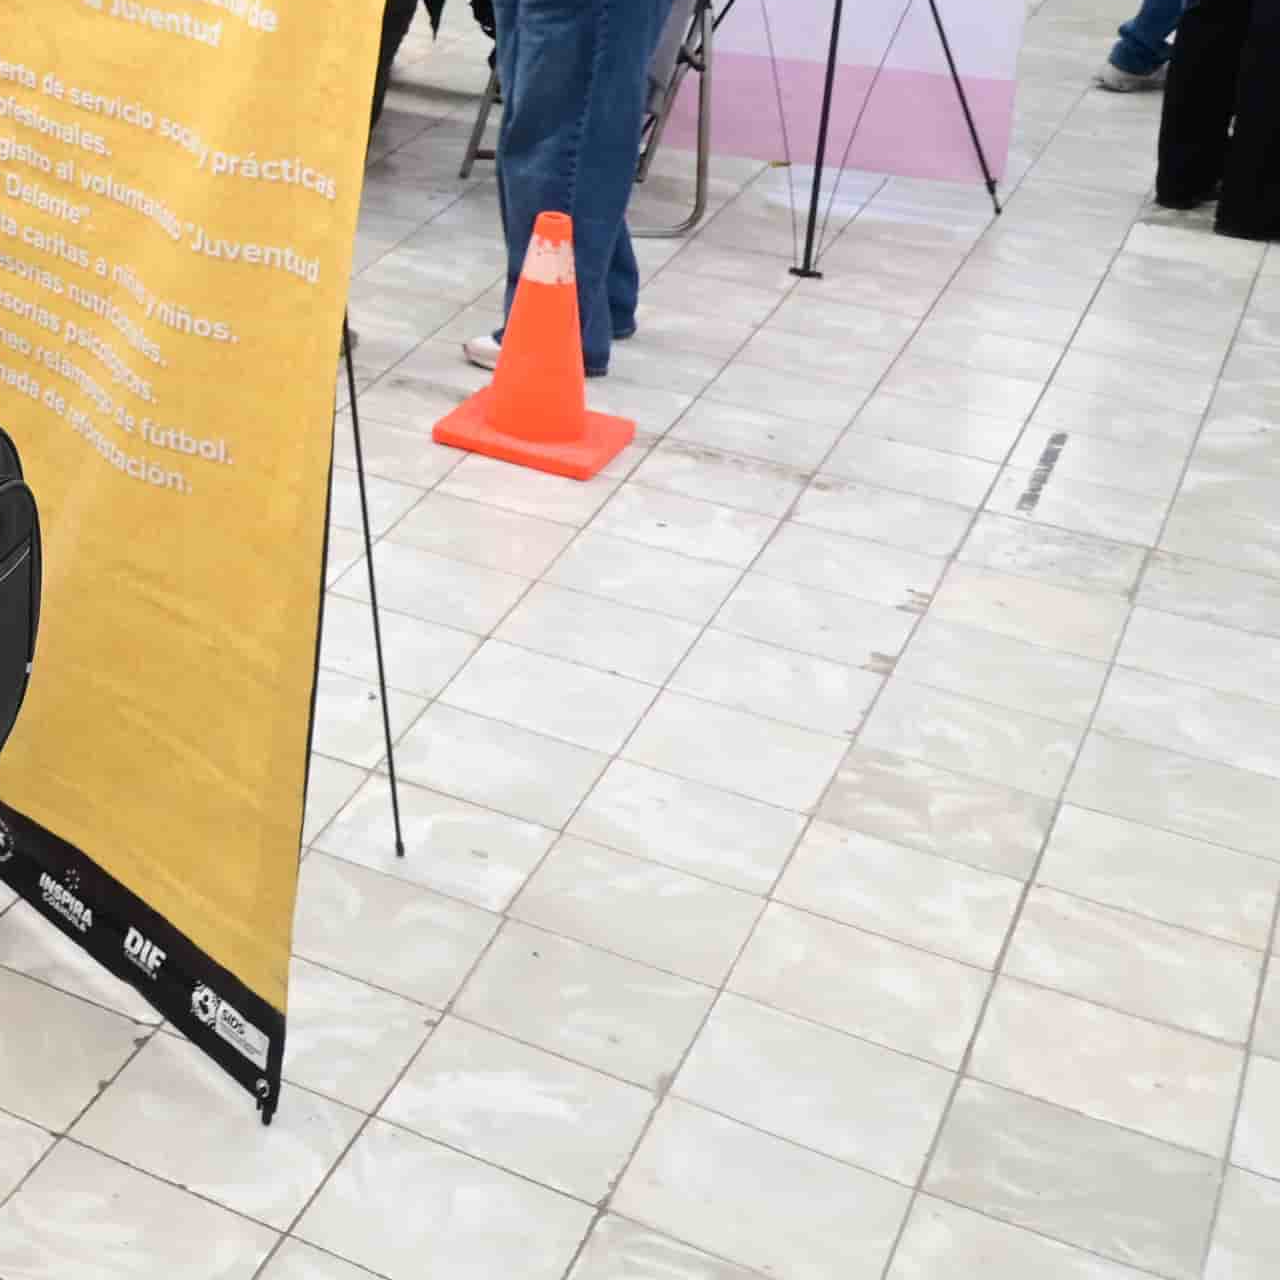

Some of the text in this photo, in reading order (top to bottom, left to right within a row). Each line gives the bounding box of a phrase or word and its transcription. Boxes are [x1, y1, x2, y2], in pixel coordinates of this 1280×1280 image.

[43, 73, 65, 101] de
[70, 86, 155, 129] servicio
[213, 151, 337, 201] prácticas
[56, 160, 75, 182] al
[23, 225, 89, 268] caritas
[95, 256, 108, 279] a
[158, 300, 241, 345] niños.
[43, 389, 65, 417] de
[40, 872, 93, 928] INSPIRA
[123, 926, 167, 970] DIF
